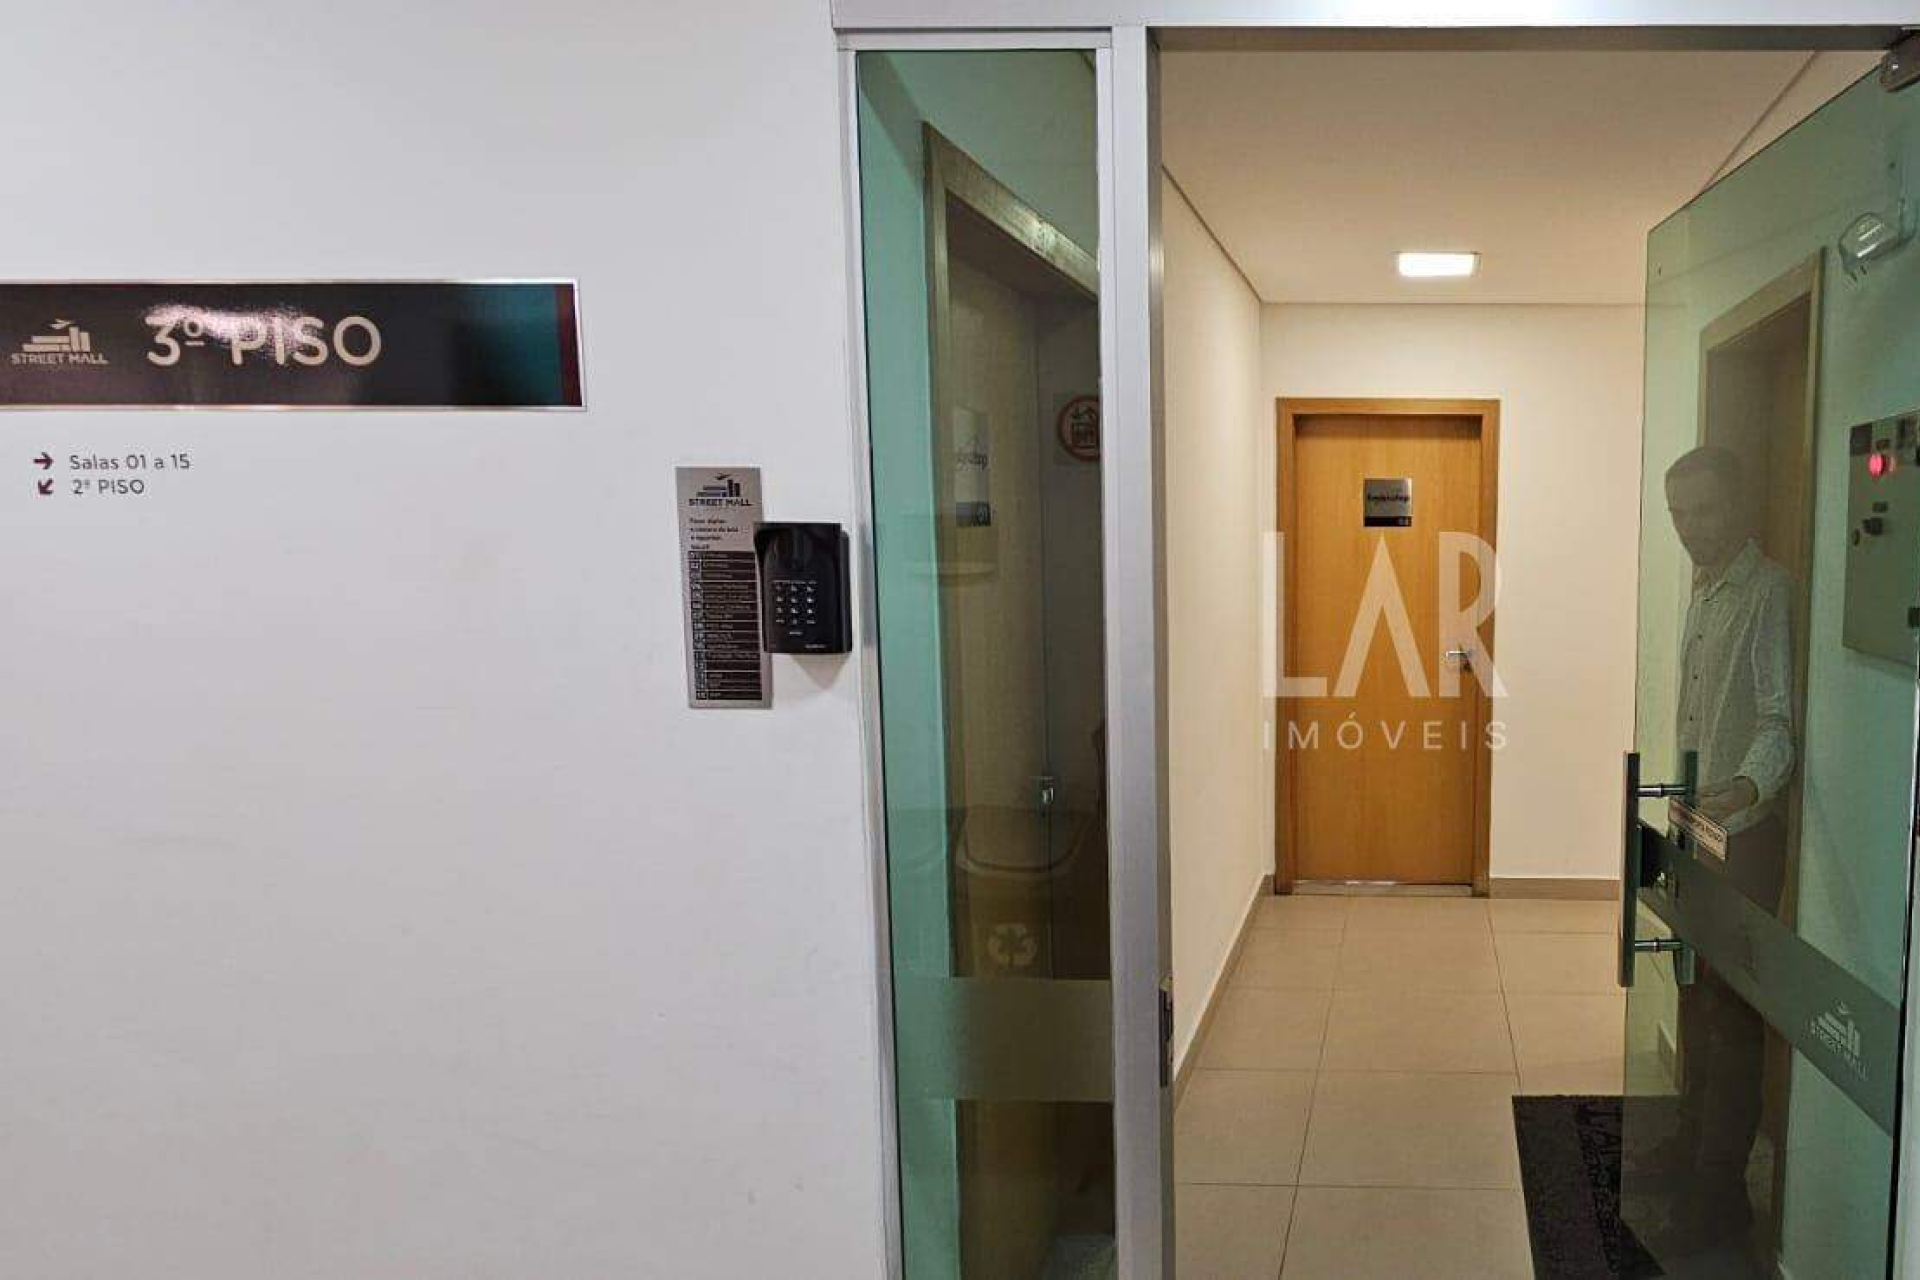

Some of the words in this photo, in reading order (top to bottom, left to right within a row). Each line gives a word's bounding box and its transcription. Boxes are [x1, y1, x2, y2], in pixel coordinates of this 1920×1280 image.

[230, 315, 382, 367] PISO
[11, 352, 64, 365] STREET
[68, 352, 110, 365] MALL
[69, 453, 119, 470] Salas
[125, 453, 147, 470] 01
[153, 457, 165, 470] a
[170, 453, 191, 470] 15
[97, 478, 146, 495] PISO
